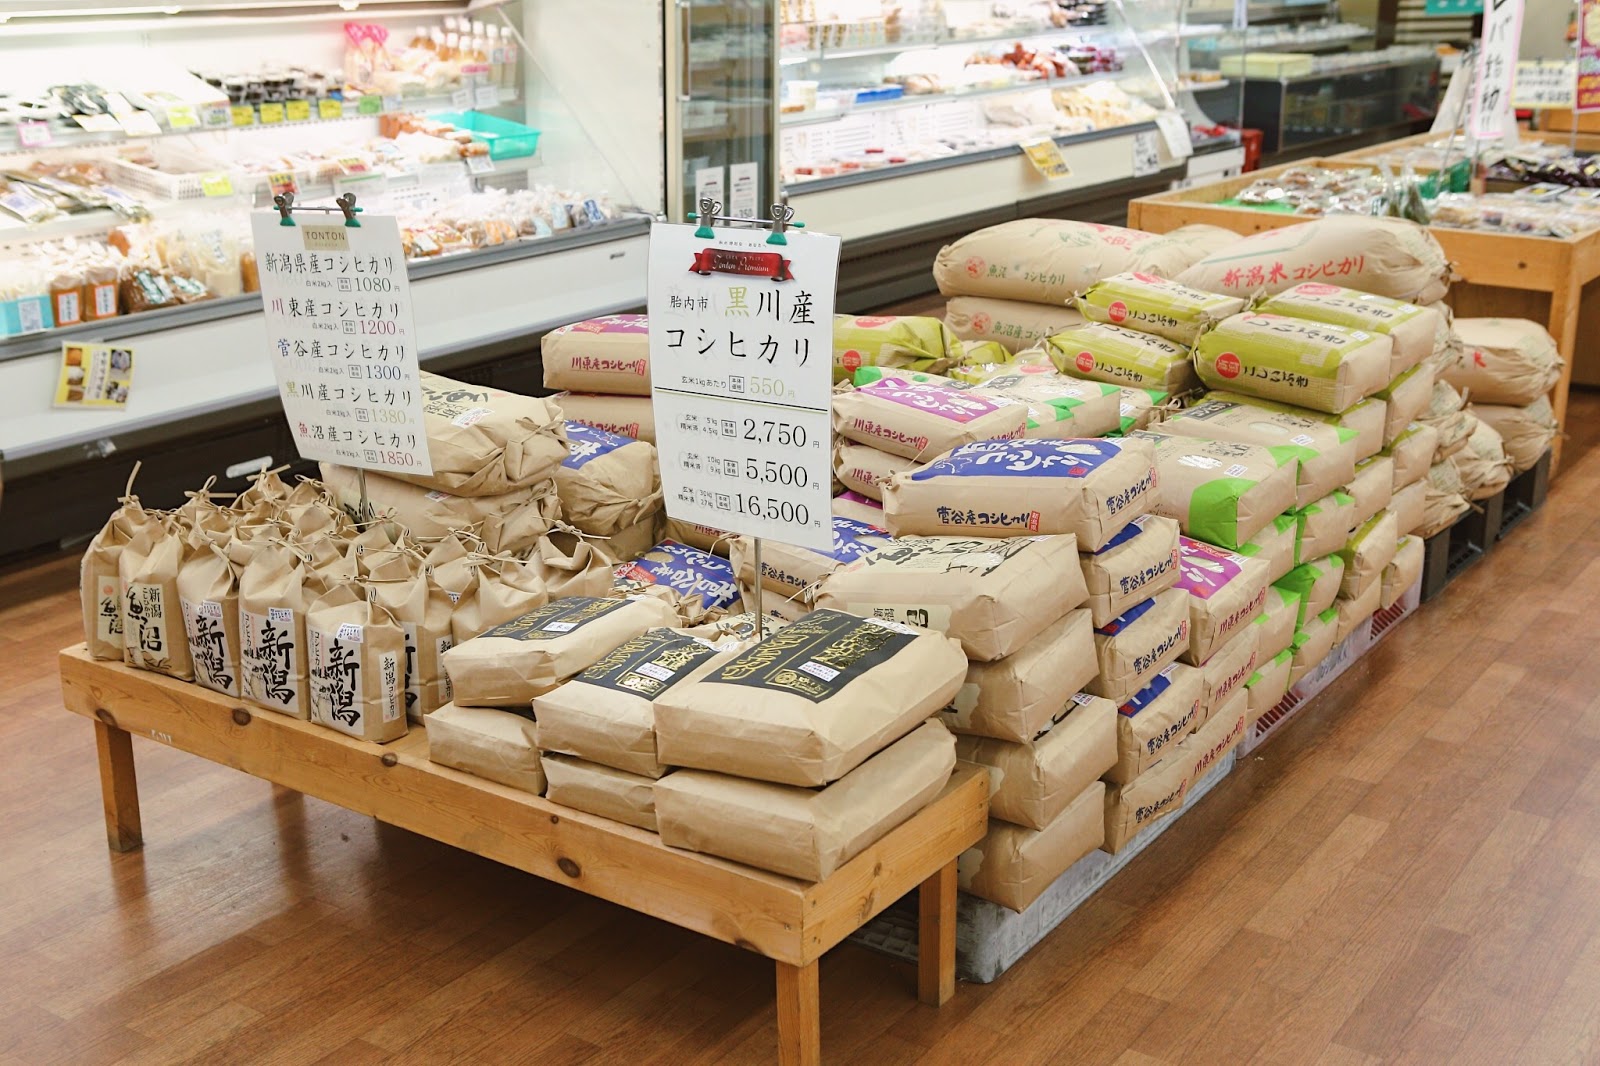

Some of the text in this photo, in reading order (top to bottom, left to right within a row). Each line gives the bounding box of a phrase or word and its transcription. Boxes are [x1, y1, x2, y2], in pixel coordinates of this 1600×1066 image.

[305, 231, 345, 241] TONTON
[265, 252, 393, 275] 新潟県産コシヒカリ
[1024, 271, 1066, 285] コシヒカリ
[1221, 261, 1288, 289] 新潟米
[1293, 255, 1365, 281] コシヒカリ
[272, 297, 399, 319] 川東産コシヒカリ
[669, 285, 815, 324] 胎内市 黒川産
[277, 339, 404, 363] 菅谷産コシヒカリ
[665, 327, 810, 369] コシヒカリ
[681, 376, 727, 389] 玄米1kgあたり
[1244, 365, 1309, 388] こしいぶき
[286, 381, 411, 407] 黒川産コシヒカリ
[298, 421, 416, 449] 魚沼産コシヒカリ
[1106, 469, 1153, 515] 菅谷産コシヒカリ
[936, 506, 1030, 528] 菅谷産コシヒカリ
[1119, 553, 1173, 596] 菅谷産コシヒカリ
[126, 586, 162, 652] 魚沼
[149, 587, 162, 619] 新潟
[195, 615, 234, 690] 新潟
[260, 619, 296, 705] 新潟
[1133, 626, 1182, 676] 菅谷産コシヒカリ
[327, 637, 361, 727] 新潟
